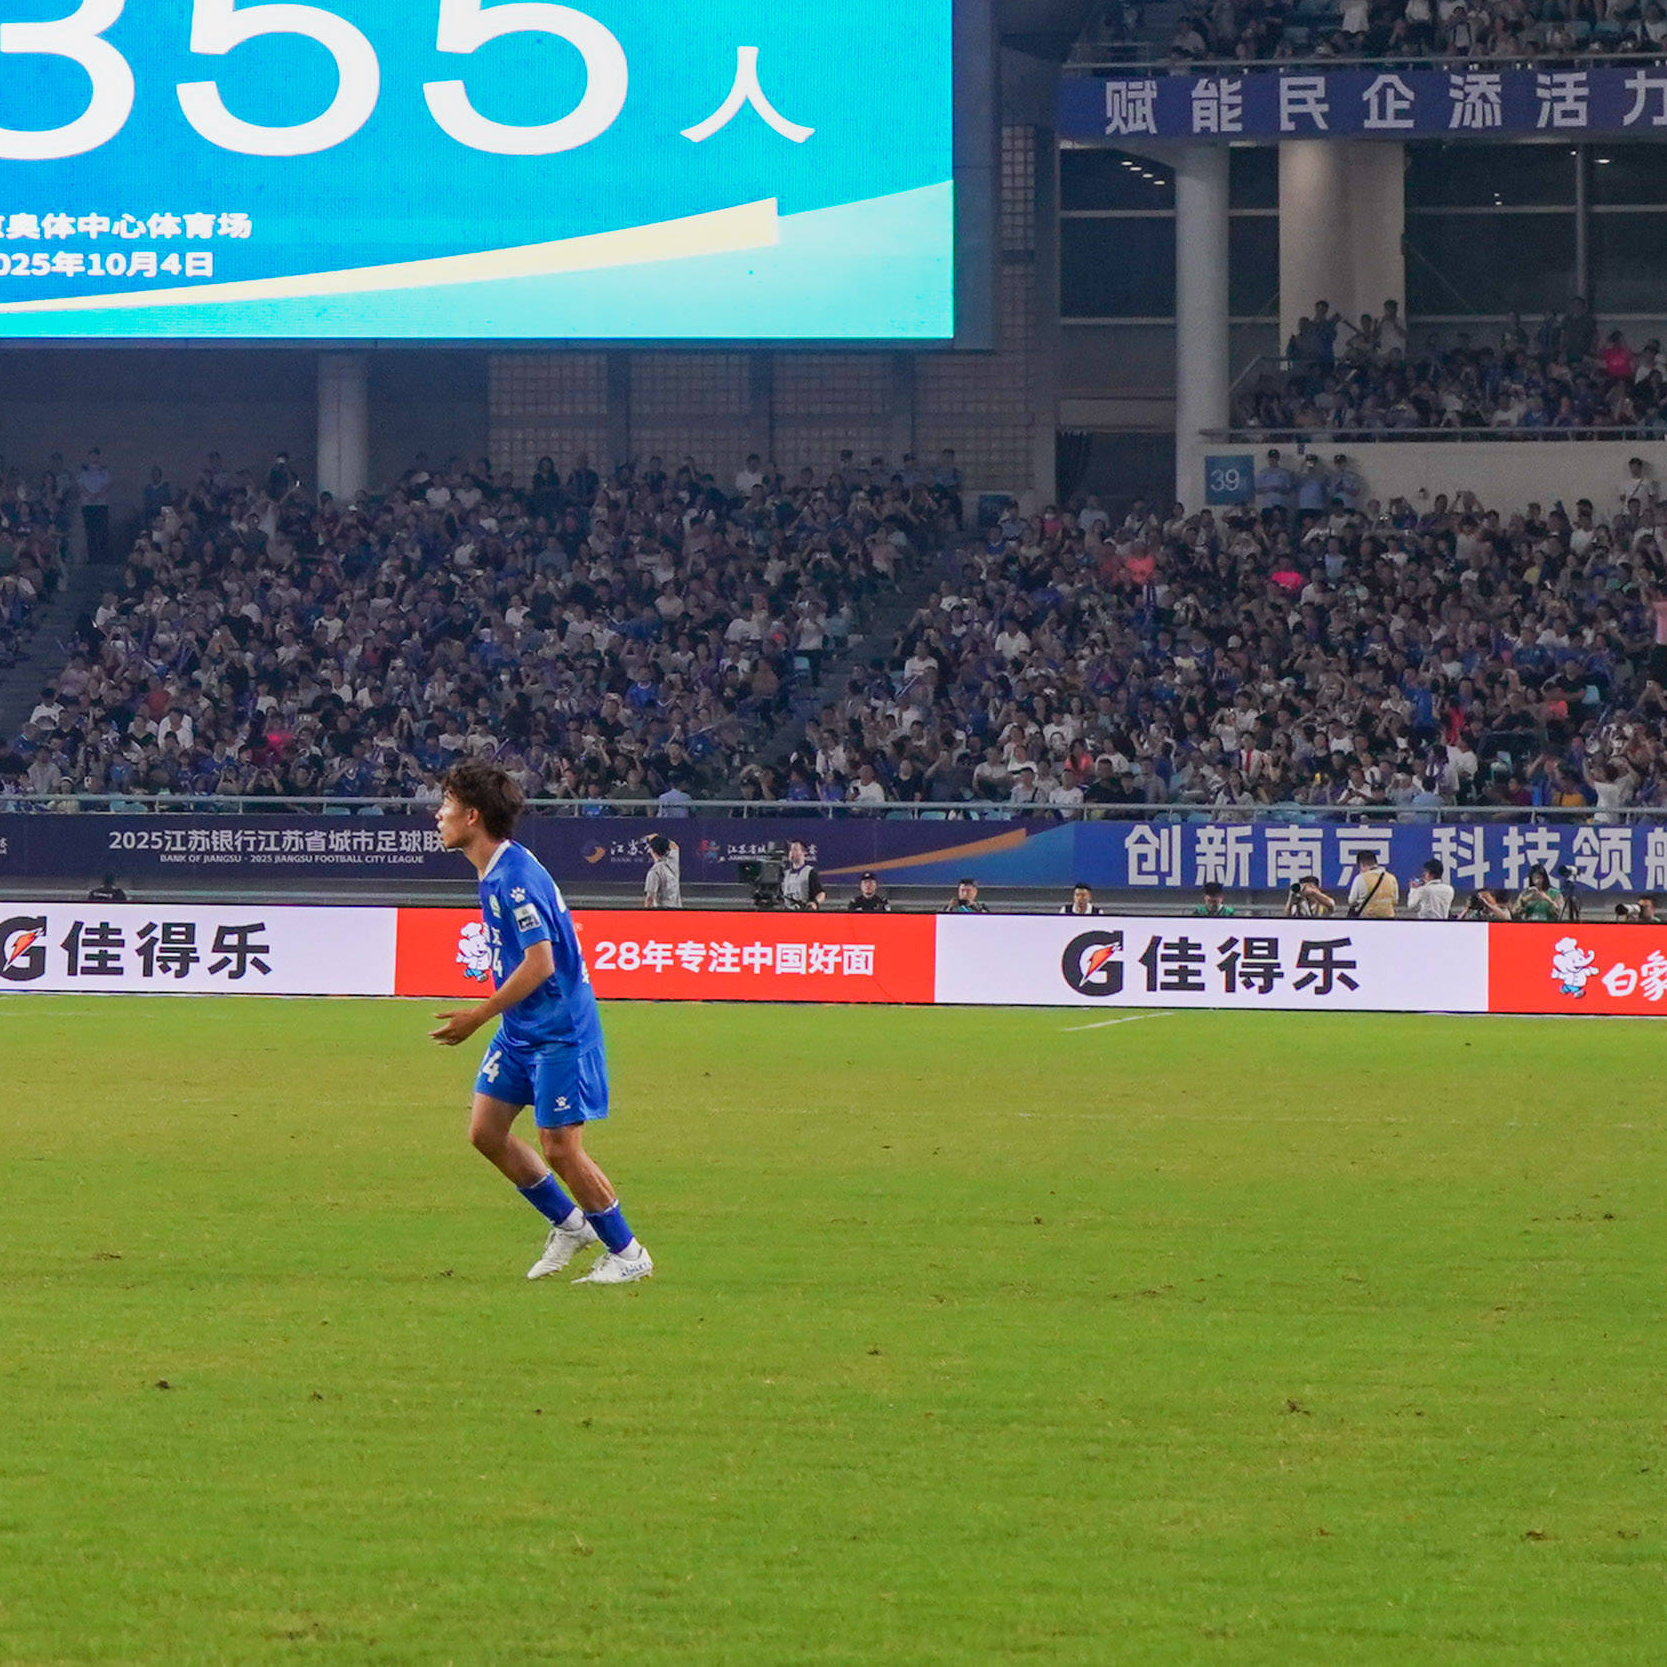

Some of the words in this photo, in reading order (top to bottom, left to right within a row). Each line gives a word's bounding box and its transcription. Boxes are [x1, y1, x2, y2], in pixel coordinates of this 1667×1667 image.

[680, 45, 815, 144] 人
[1105, 70, 1667, 135] 赋能民企添活力
[108, 830, 449, 853] 2025江苏银行江苏省城市足球联
[160, 854, 186, 863] BANK
[188, 854, 201, 863] OF
[250, 854, 272, 863] 2025
[1124, 824, 1394, 888] 创新南京
[61, 920, 272, 980] 佳得乐
[594, 940, 876, 976] 28年专注中国好面
[1138, 935, 1360, 996] 佳得乐
